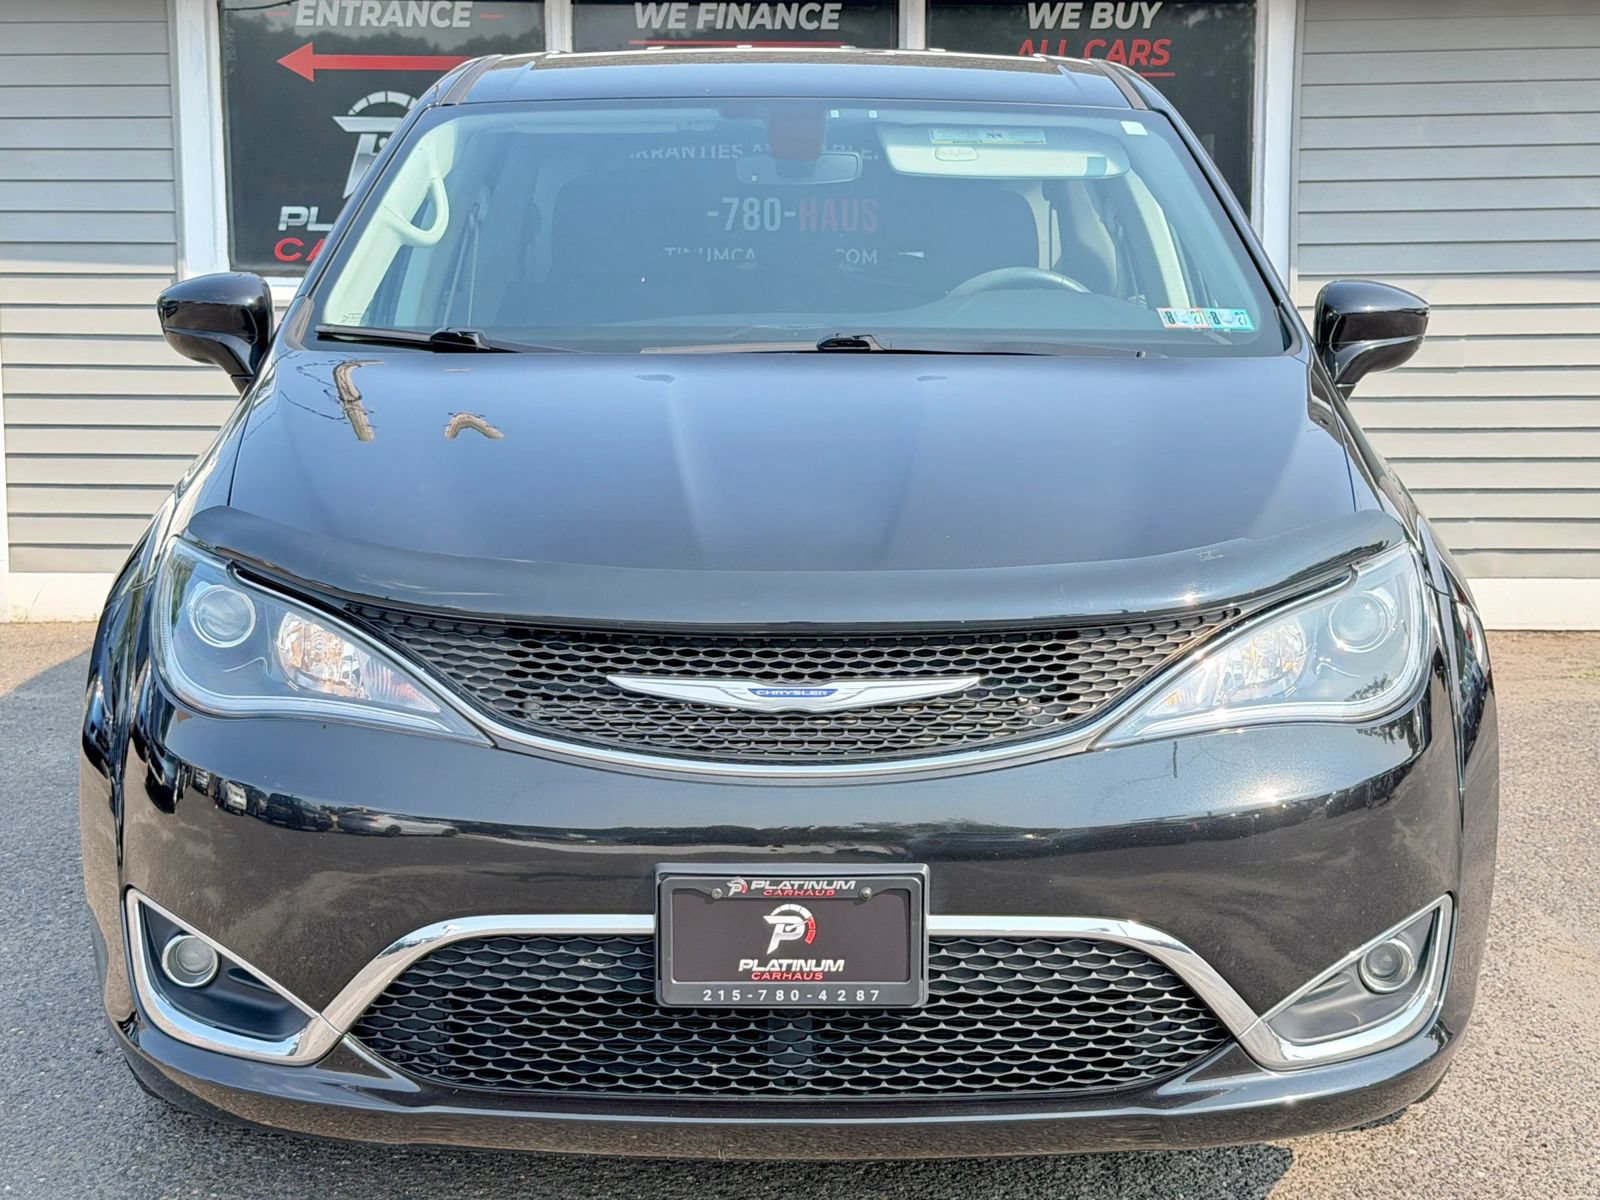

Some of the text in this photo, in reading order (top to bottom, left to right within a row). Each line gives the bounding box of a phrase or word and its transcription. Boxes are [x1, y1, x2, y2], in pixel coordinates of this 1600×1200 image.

[295, 0, 473, 28] ENTRANCE
[634, 2, 842, 30] WE FINANCE
[1027, 2, 1163, 30] WE BUY
[1083, 38, 1172, 66] CARS
[750, 880, 856, 890] PLATINUM
[738, 959, 845, 972] PLATINUM
[751, 972, 824, 980] CARHAUS
